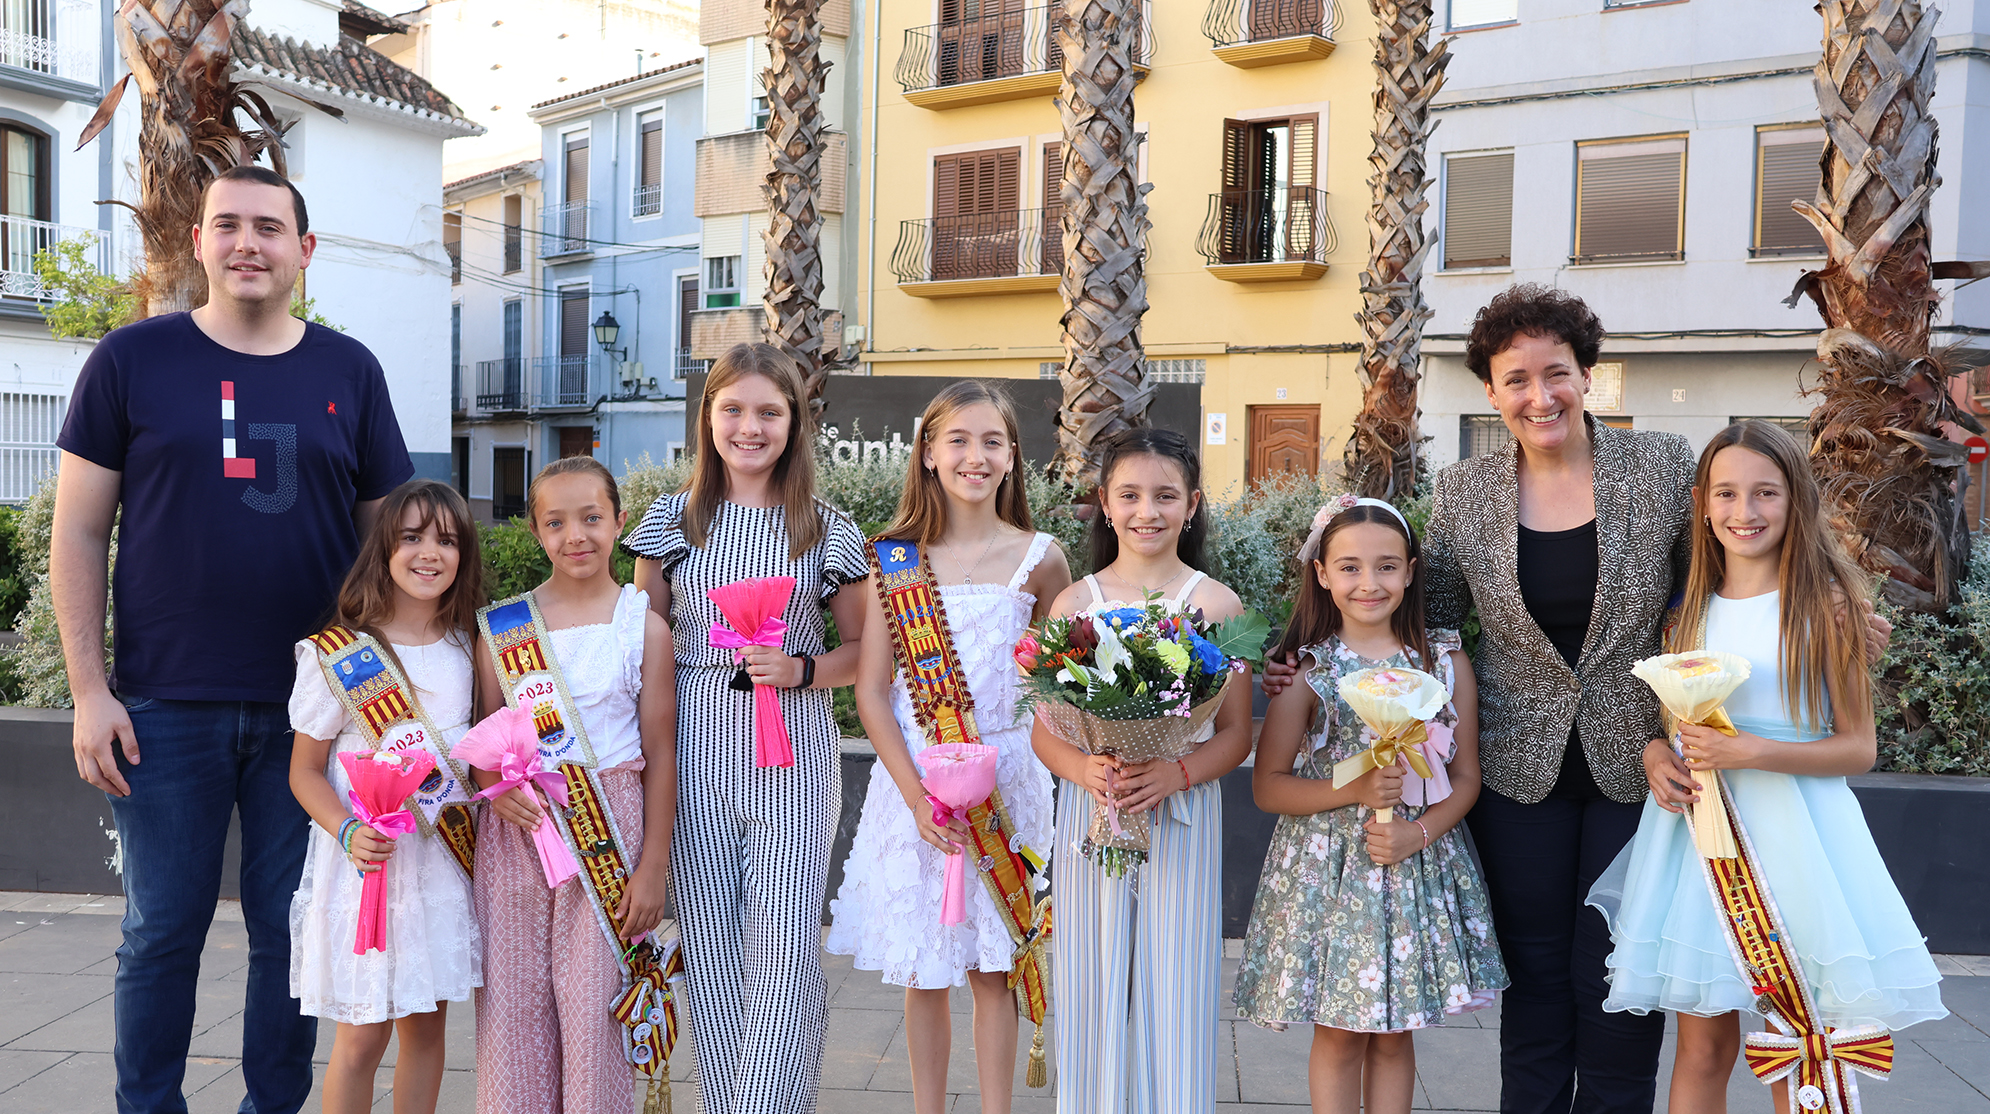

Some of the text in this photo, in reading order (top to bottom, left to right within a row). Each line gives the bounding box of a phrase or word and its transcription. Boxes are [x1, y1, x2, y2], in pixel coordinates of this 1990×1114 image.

[1276, 388, 1287, 399] 23
[1673, 389, 1685, 401] 24
[889, 546, 907, 563] R
[896, 604, 934, 627] 2023
[913, 674, 930, 686] FIRA
[555, 735, 577, 757] D'ONDA
[417, 779, 455, 806] FIRA D'ONDA
[568, 780, 599, 848] Dama
[969, 805, 1011, 869] nfantil
[1726, 875, 1782, 974] Infantil
